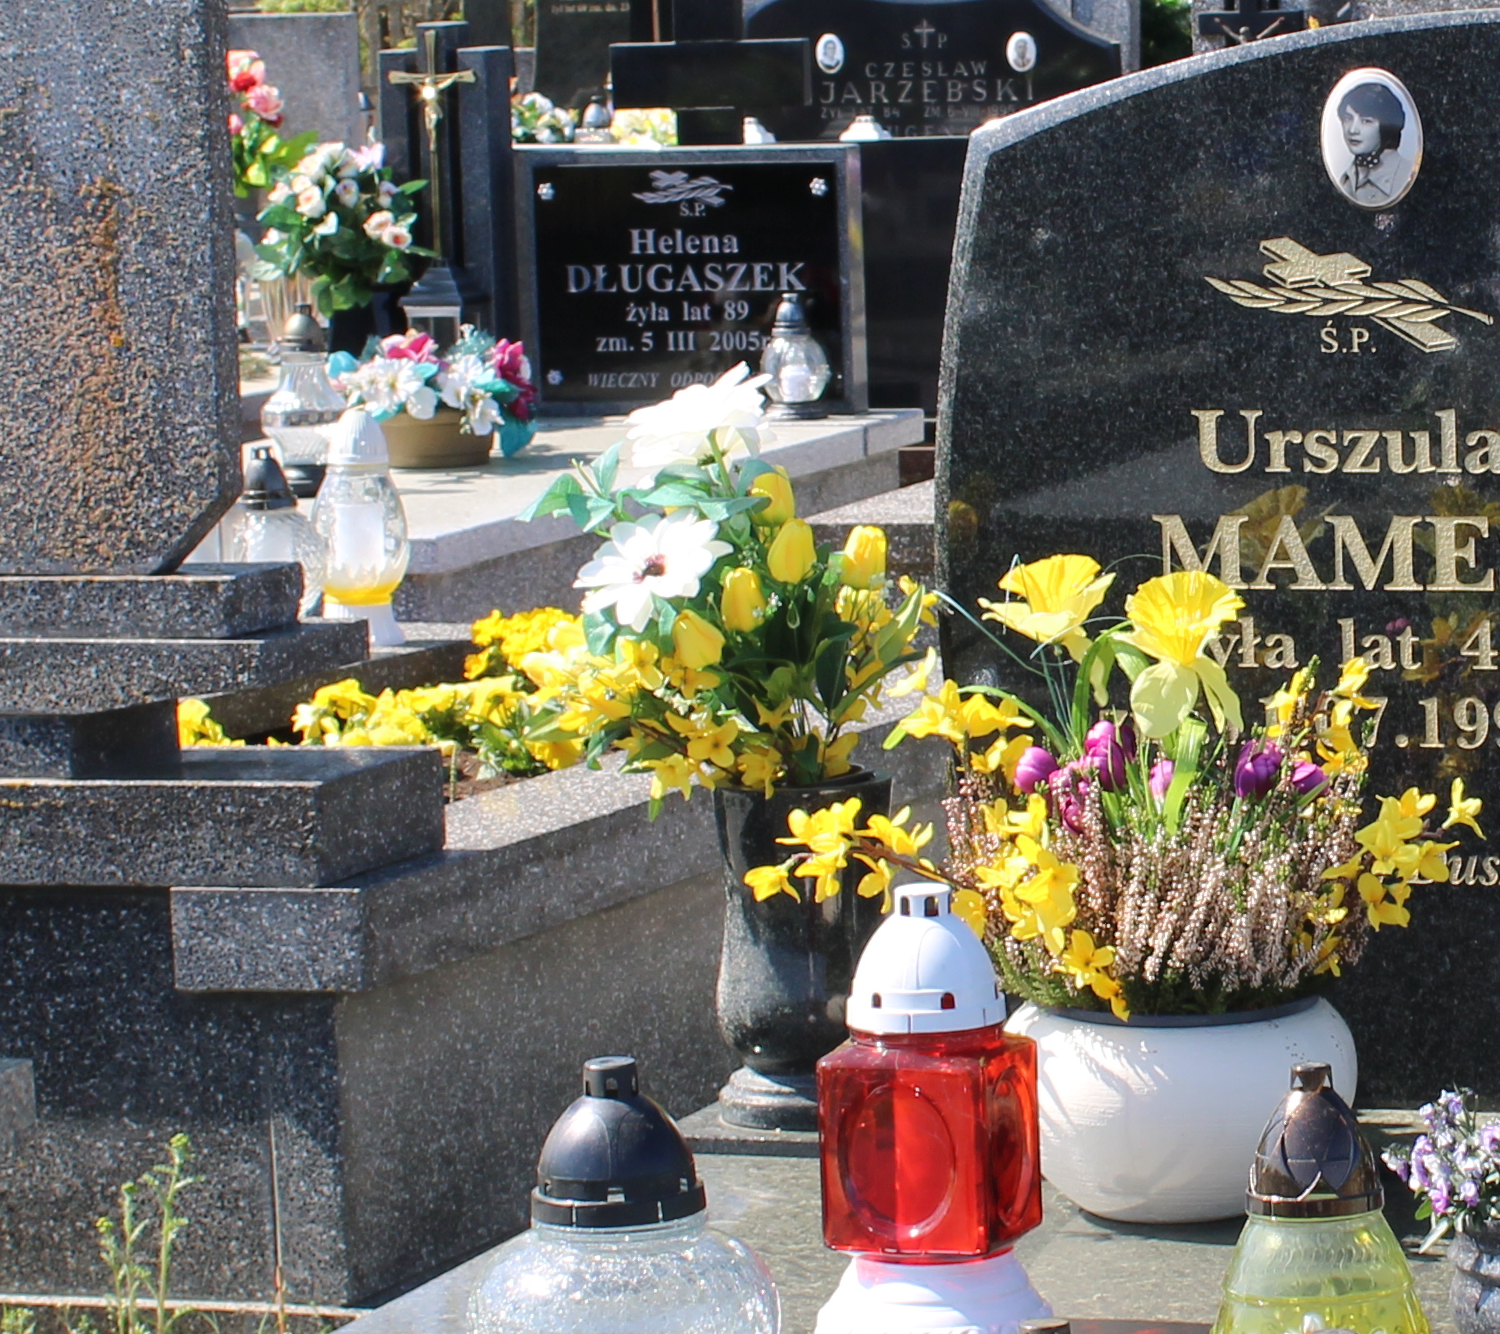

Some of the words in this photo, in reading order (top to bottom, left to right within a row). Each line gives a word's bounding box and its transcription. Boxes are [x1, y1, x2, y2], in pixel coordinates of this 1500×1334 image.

[629, 228, 740, 255] Helena
[566, 261, 807, 294] DŁUGASZEK
[626, 301, 670, 327] żyła
[682, 301, 711, 322] lat
[723, 299, 750, 322] 89
[596, 336, 636, 353] zm.
[641, 331, 654, 352] 5
[666, 331, 696, 352] III
[1320, 319, 1378, 355] Ś.P.
[587, 372, 660, 389] WIECZNY
[1207, 616, 1300, 670] yła
[1337, 616, 1422, 672] lat
